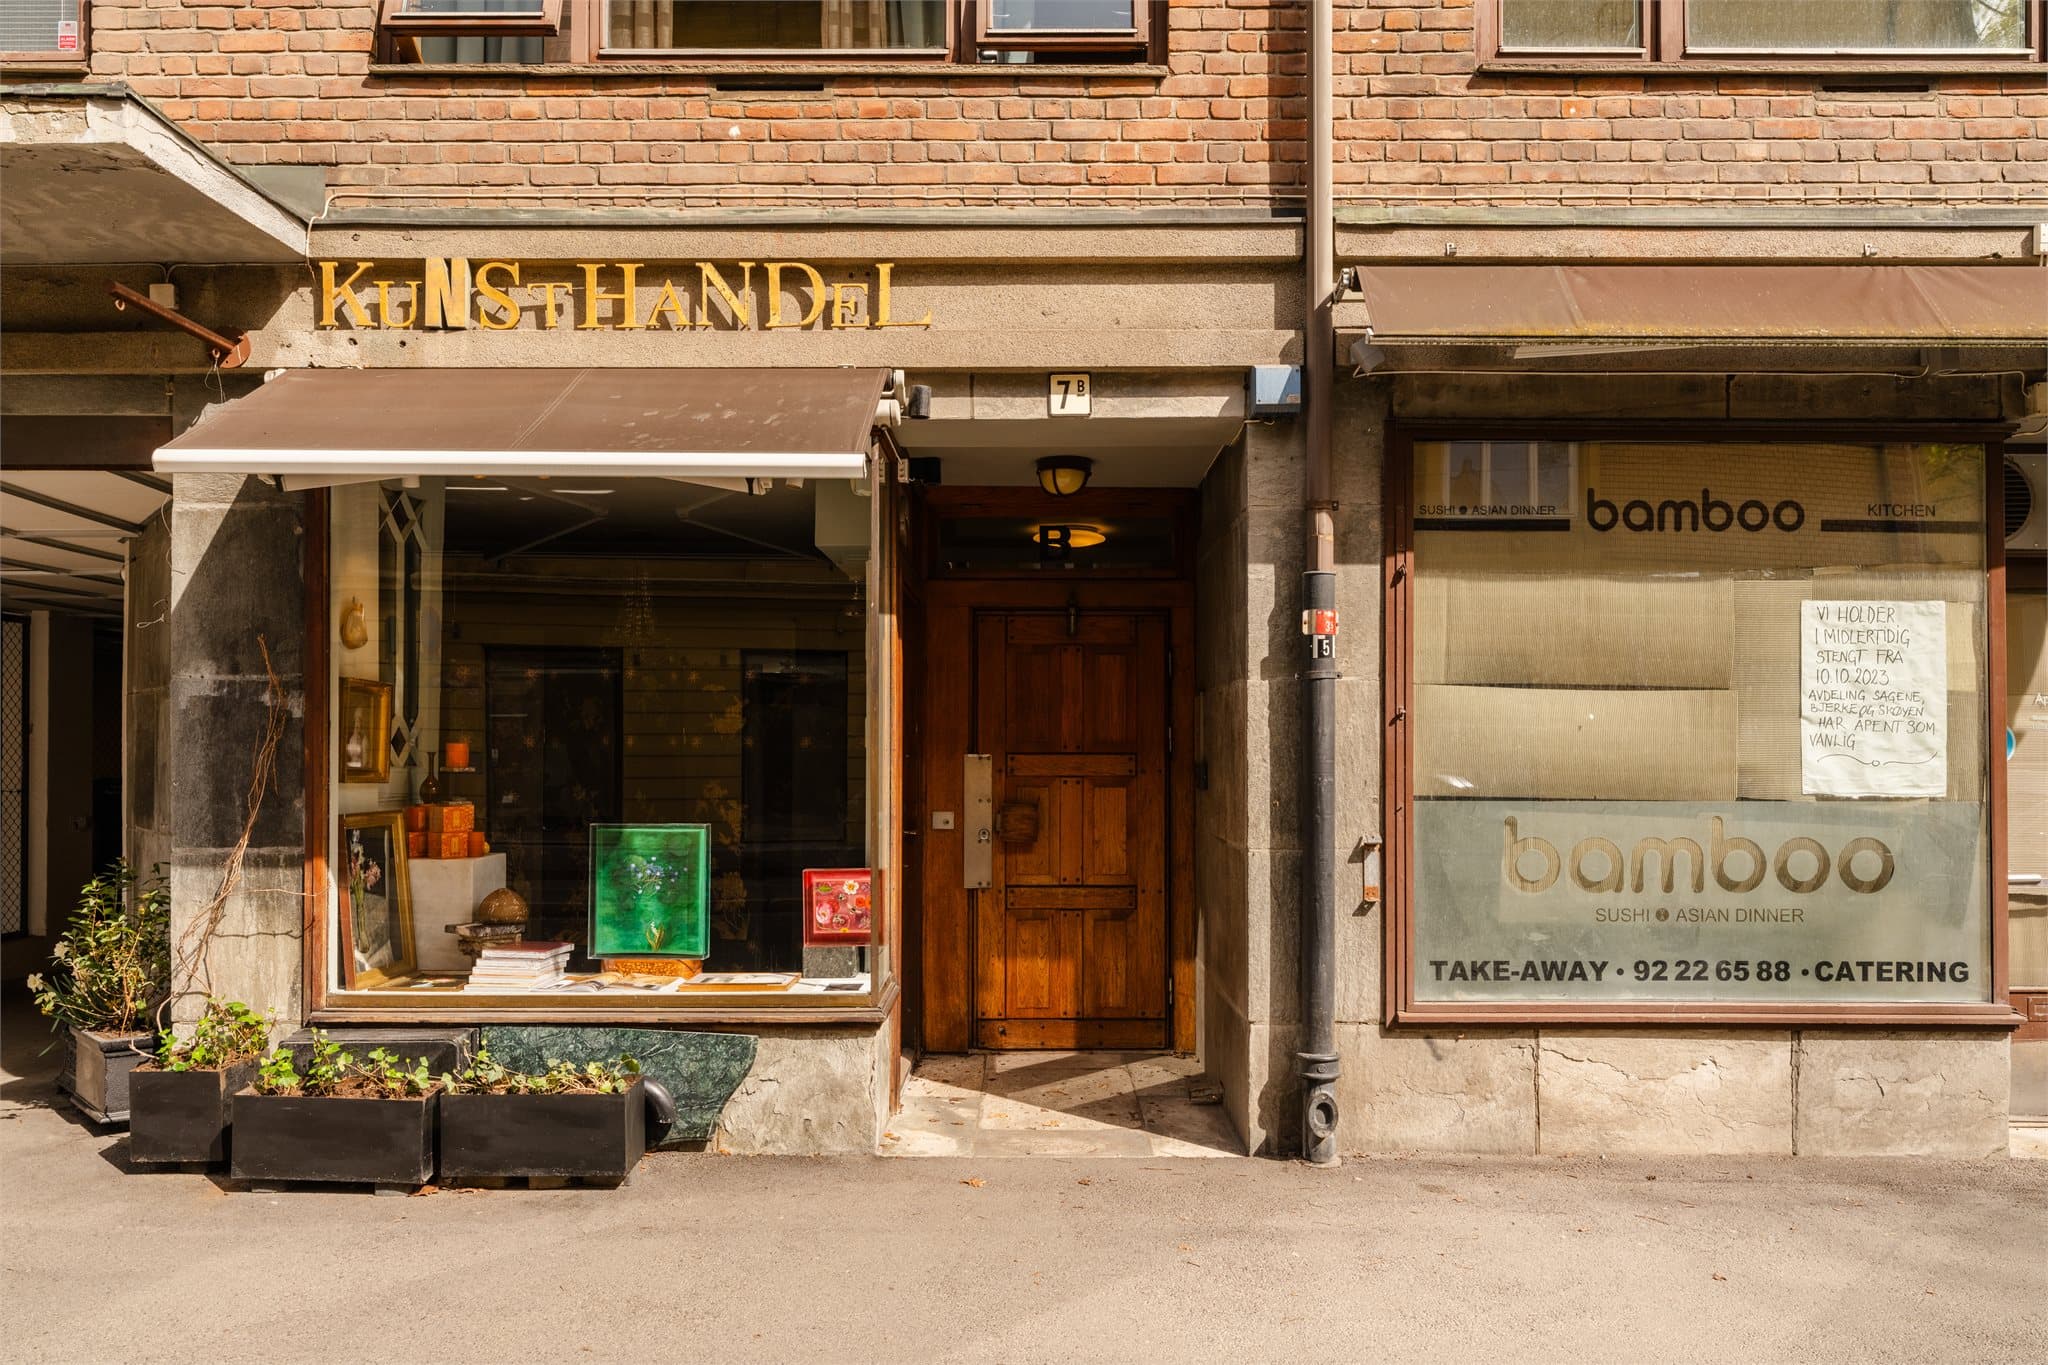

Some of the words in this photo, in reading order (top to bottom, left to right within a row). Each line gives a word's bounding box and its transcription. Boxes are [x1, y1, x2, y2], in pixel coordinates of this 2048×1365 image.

[318, 257, 932, 330] KUNSTHANDEL
[1419, 505, 1455, 515] SUSHI
[1472, 505, 1508, 515] ASIAN
[1511, 505, 1557, 515] DINNER
[1587, 487, 1805, 532] bamboo
[1867, 503, 1936, 518] KITCHEN
[1040, 526, 1072, 560] B
[1816, 605, 1829, 621] VI
[1838, 605, 1895, 624] HOLDER
[1824, 627, 1910, 648] MIDLERTIDIG
[1816, 649, 1868, 666] STENGT
[1876, 649, 1903, 664] FRA
[1816, 668, 1890, 686] 10.10.2023
[1809, 689, 1866, 702] AVDELING
[1810, 702, 1857, 714] BJERKE
[1878, 704, 1925, 717] SKØYEN
[1816, 716, 1847, 730] HAR
[1906, 720, 1935, 736] SOM
[1809, 733, 1856, 751] VANLIG
[1504, 815, 1895, 894] bamboo
[1595, 907, 1650, 922] SUSHI
[1676, 907, 1729, 922] ASIAN
[1735, 907, 1804, 922] DINNER
[1429, 960, 1608, 982] TAKE-AWAY
[1815, 960, 1970, 983] CATERING
